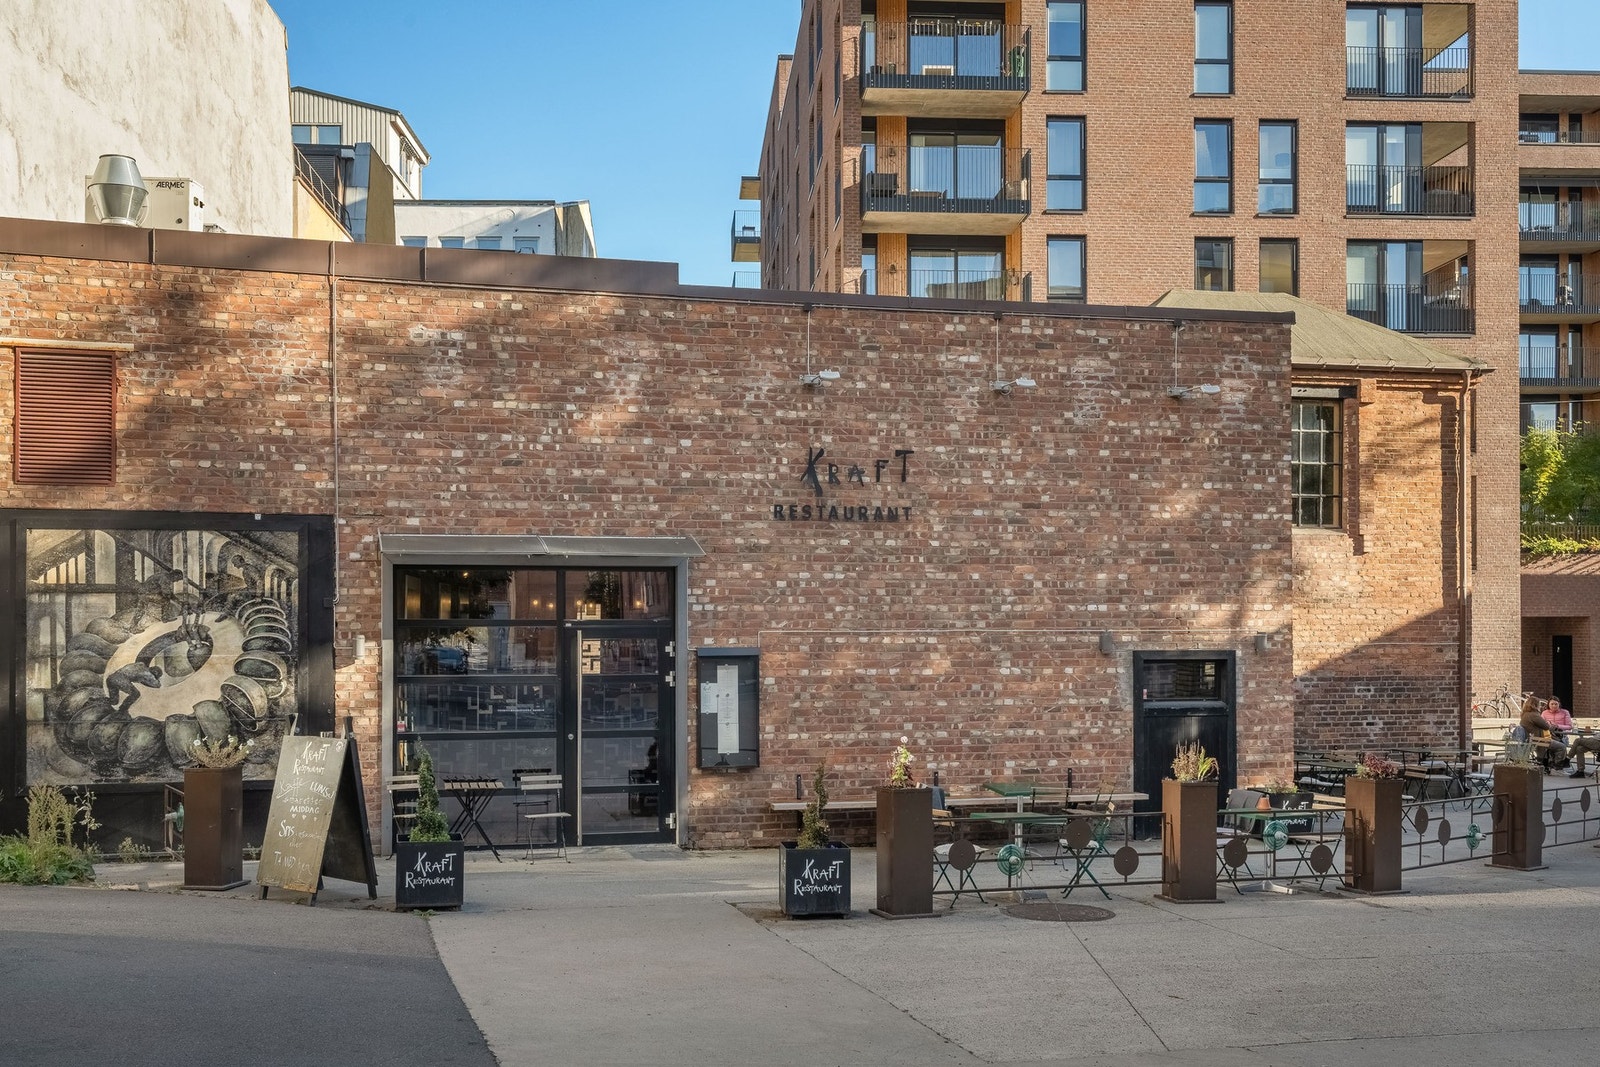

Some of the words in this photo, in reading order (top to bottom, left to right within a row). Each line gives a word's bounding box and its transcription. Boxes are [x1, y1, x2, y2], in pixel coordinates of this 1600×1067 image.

[156, 181, 185, 189] AERMEC
[800, 447, 914, 497] KRAFT
[773, 504, 912, 521] RESTAURANT
[290, 805, 320, 814] MIDDAG
[413, 851, 457, 877] KRAFT
[801, 859, 843, 884] KRAFT
[405, 871, 456, 889] RESTAURANT
[794, 879, 842, 896] RESTAURANT
